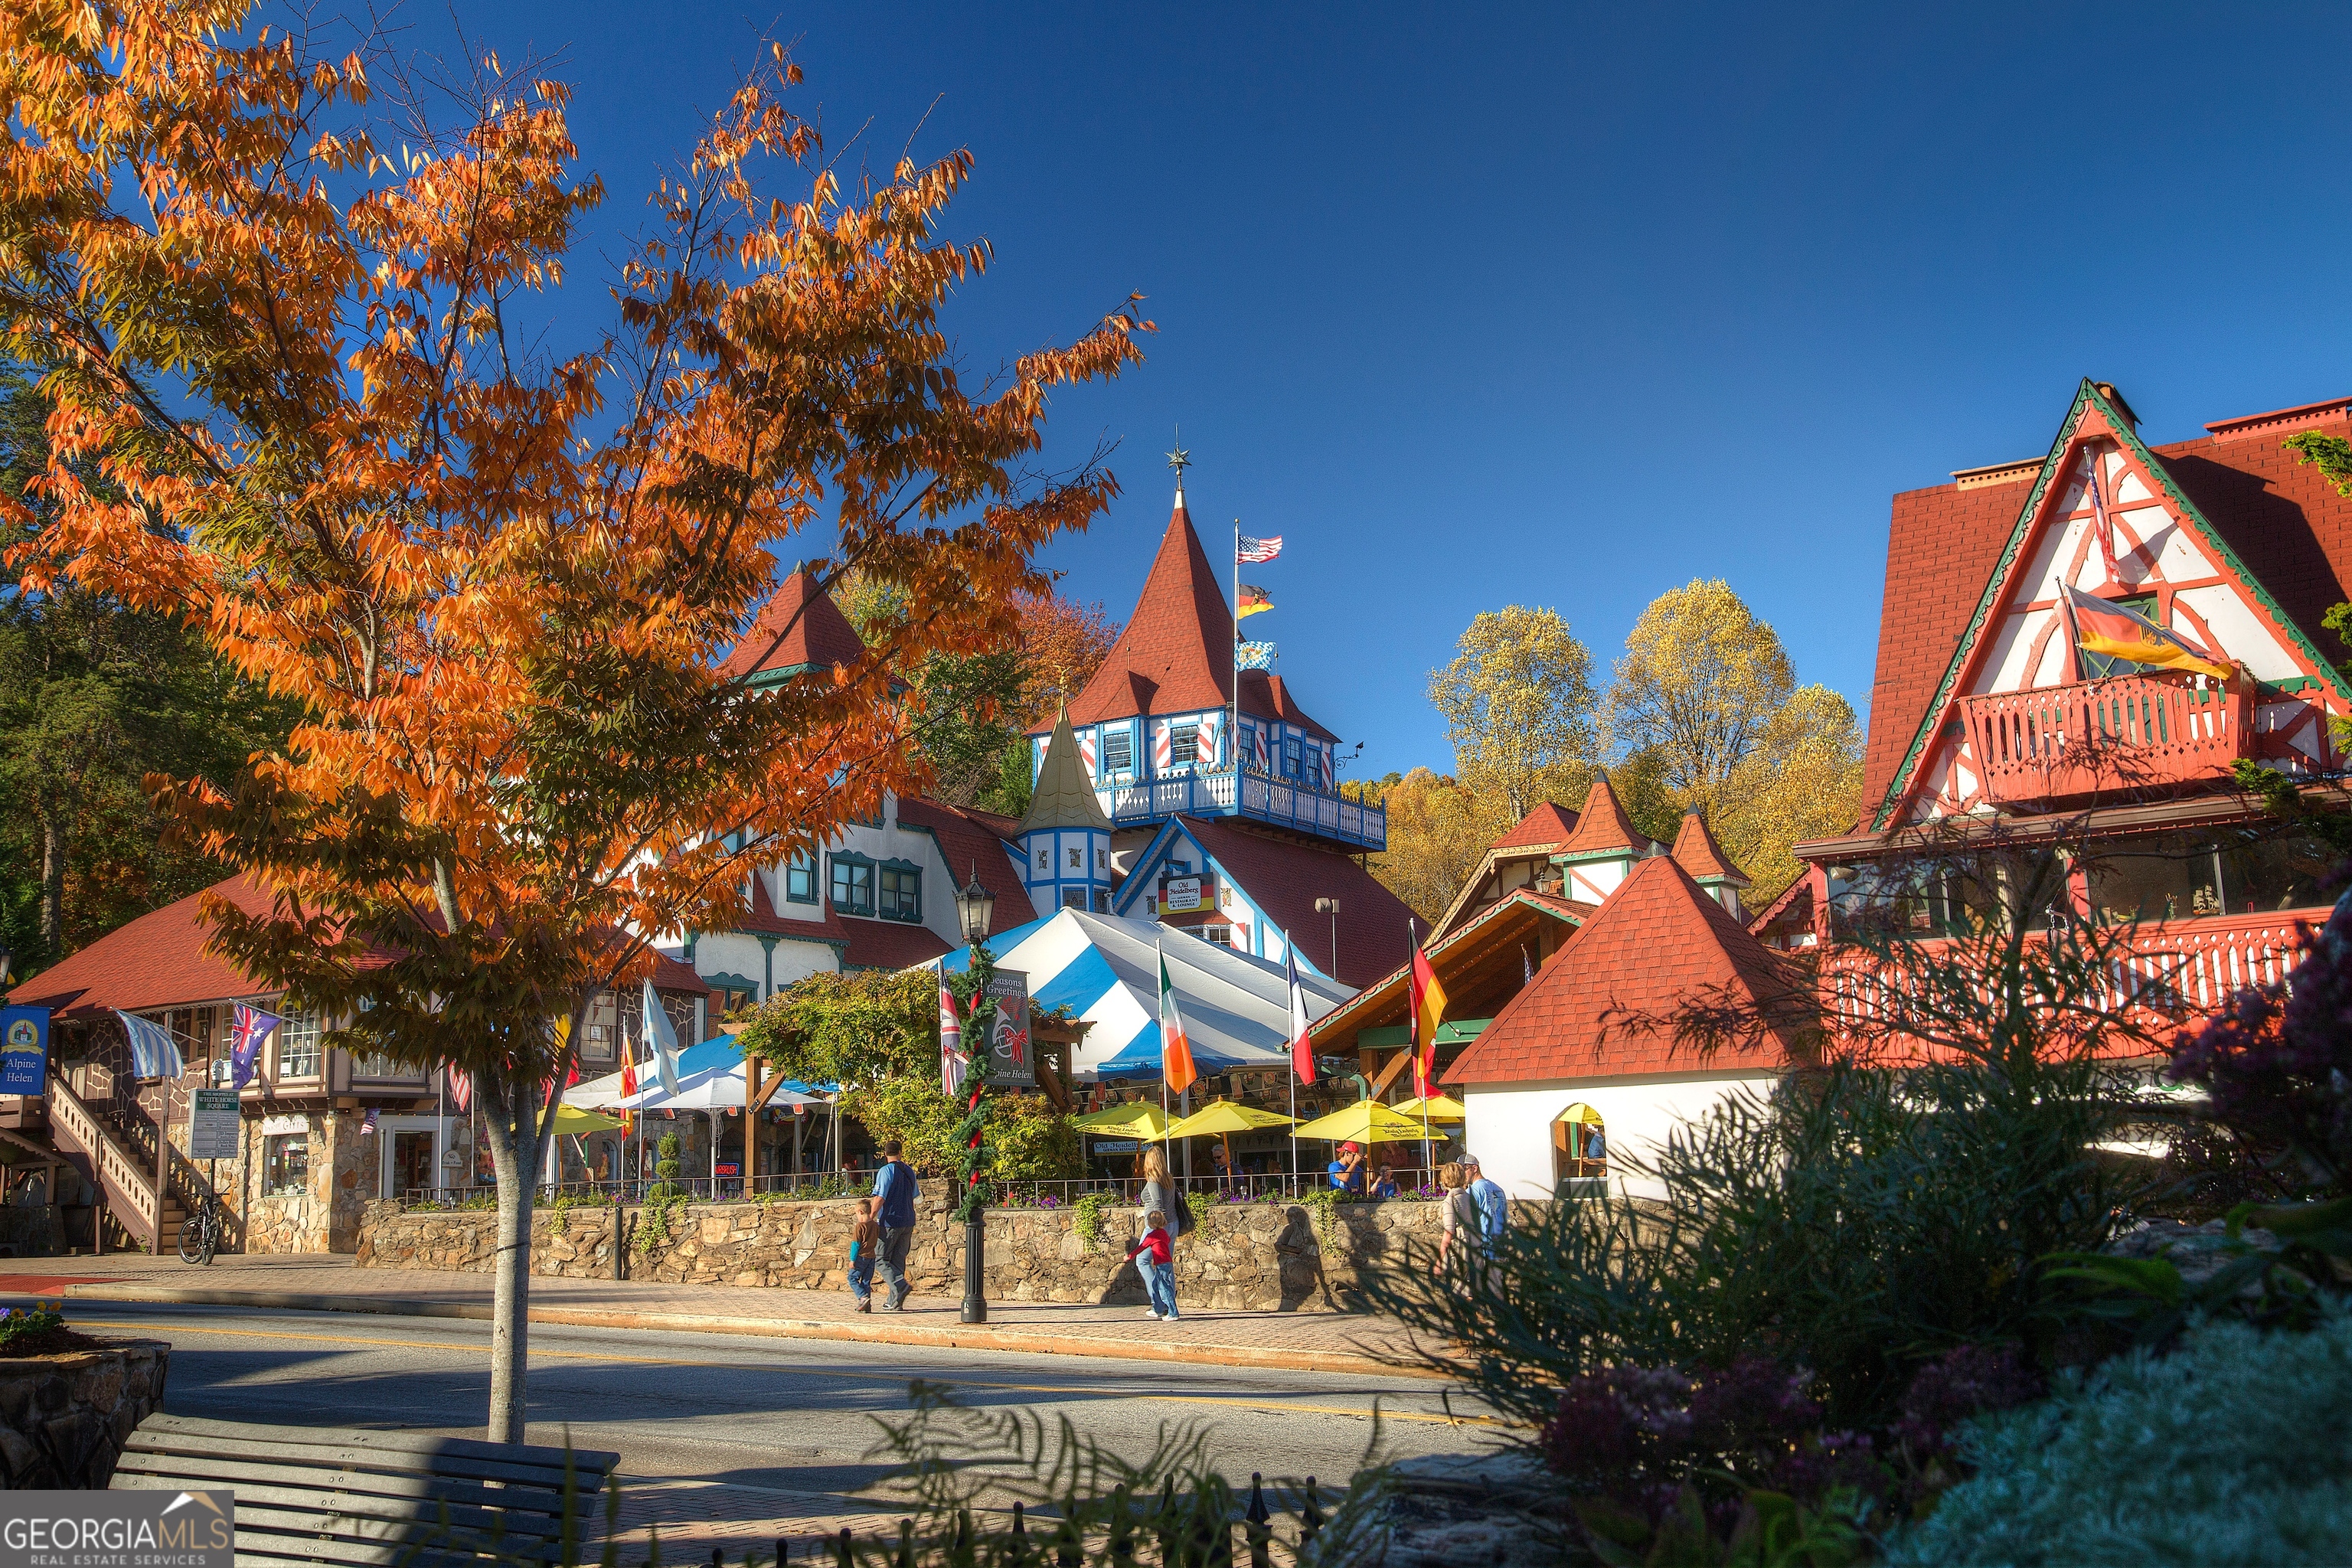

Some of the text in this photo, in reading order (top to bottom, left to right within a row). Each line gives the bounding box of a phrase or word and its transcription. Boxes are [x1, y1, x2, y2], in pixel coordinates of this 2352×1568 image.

[987, 985, 1026, 999] Greetings
[6, 1058, 37, 1070] Alpine
[7, 1072, 33, 1083] Helen
[994, 1068, 1032, 1080] pine Helen
